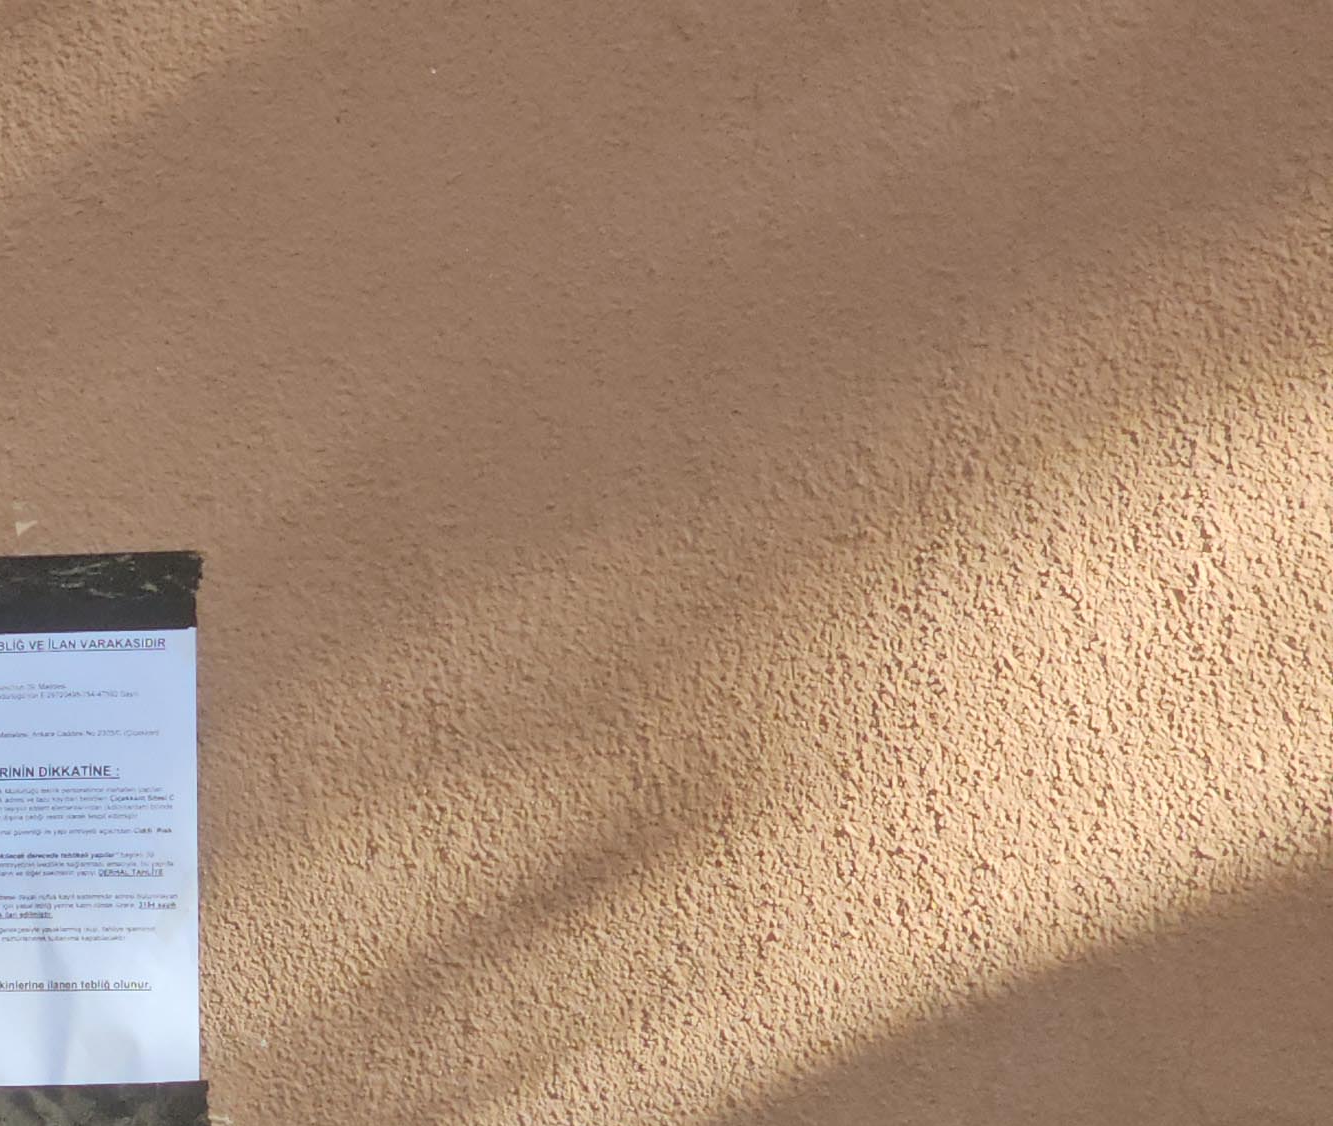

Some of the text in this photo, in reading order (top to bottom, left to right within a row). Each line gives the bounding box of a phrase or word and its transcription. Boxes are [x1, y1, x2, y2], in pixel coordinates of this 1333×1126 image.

[29, 640, 44, 651] VE
[48, 637, 76, 650] İLAN
[80, 637, 166, 650] VARAKASIDIR
[38, 763, 112, 778] DİKKATİNE
[47, 979, 77, 991] ilanen
[81, 979, 111, 991] tebliğ
[113, 978, 153, 991] olunur.
